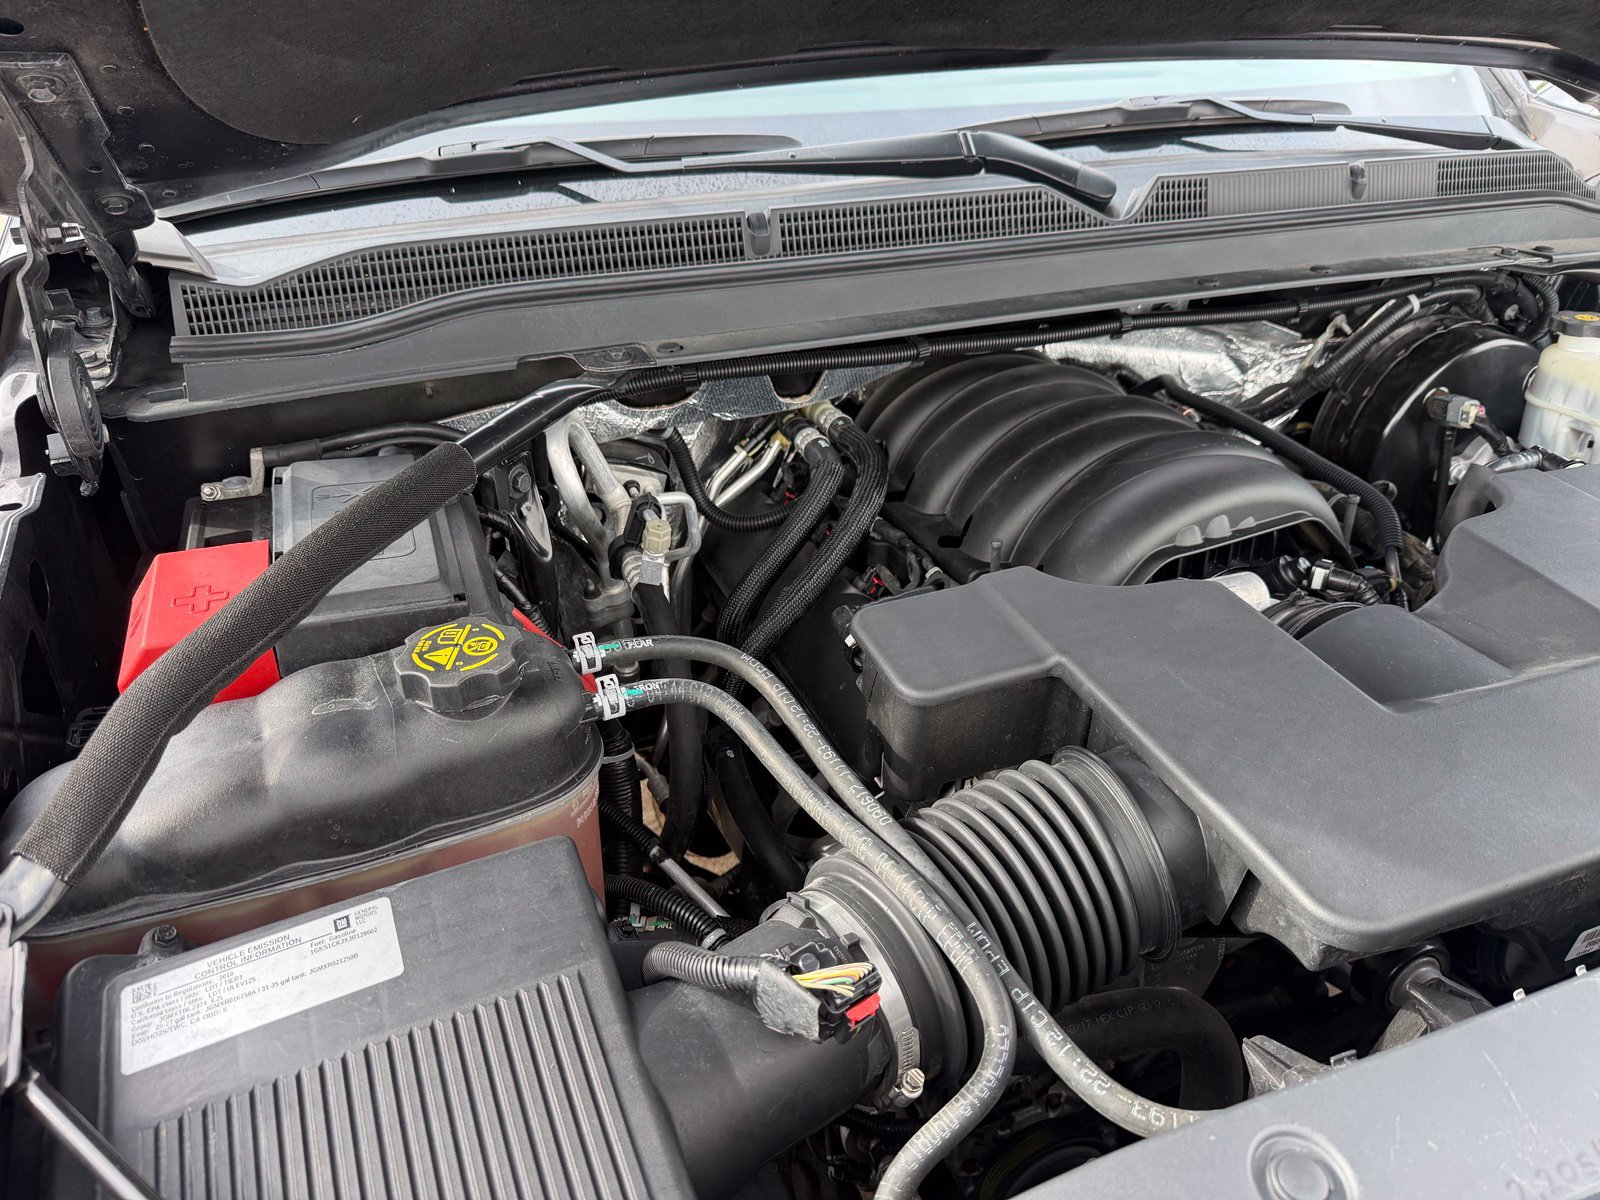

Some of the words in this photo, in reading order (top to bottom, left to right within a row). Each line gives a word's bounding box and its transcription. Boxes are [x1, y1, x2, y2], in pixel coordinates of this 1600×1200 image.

[740, 651, 776, 684] EPDM
[354, 905, 377, 916] GENERAL
[355, 910, 376, 921] MOTORS
[206, 951, 244, 968] VEHICLE
[248, 935, 289, 953] EMISSION
[311, 939, 325, 948] Fuel:
[329, 929, 355, 941] Gasoline
[195, 960, 238, 979] CONTROL
[241, 938, 300, 963] INFORMATION
[132, 998, 162, 1012] Conforms
[174, 979, 213, 998] Regulations:
[219, 971, 233, 981] 2018
[132, 1010, 142, 1018] U.S.
[147, 1004, 159, 1013] EPA
[162, 997, 178, 1008] class
[205, 984, 217, 992] LDT
[224, 975, 242, 985] TIER3
[132, 1011, 163, 1025] California
[165, 1003, 181, 1014] class
[208, 989, 220, 998] LDT
[227, 978, 255, 991] ULEV125
[175, 1015, 185, 1024] gal
[187, 1008, 202, 1019] tank:
[280, 976, 290, 986] gal
[292, 971, 306, 981] tank:
[132, 1020, 152, 1033] Group:
[210, 994, 223, 1004] 6.2L
[190, 1016, 200, 1025] CA
[202, 1009, 221, 1021] OBD:
